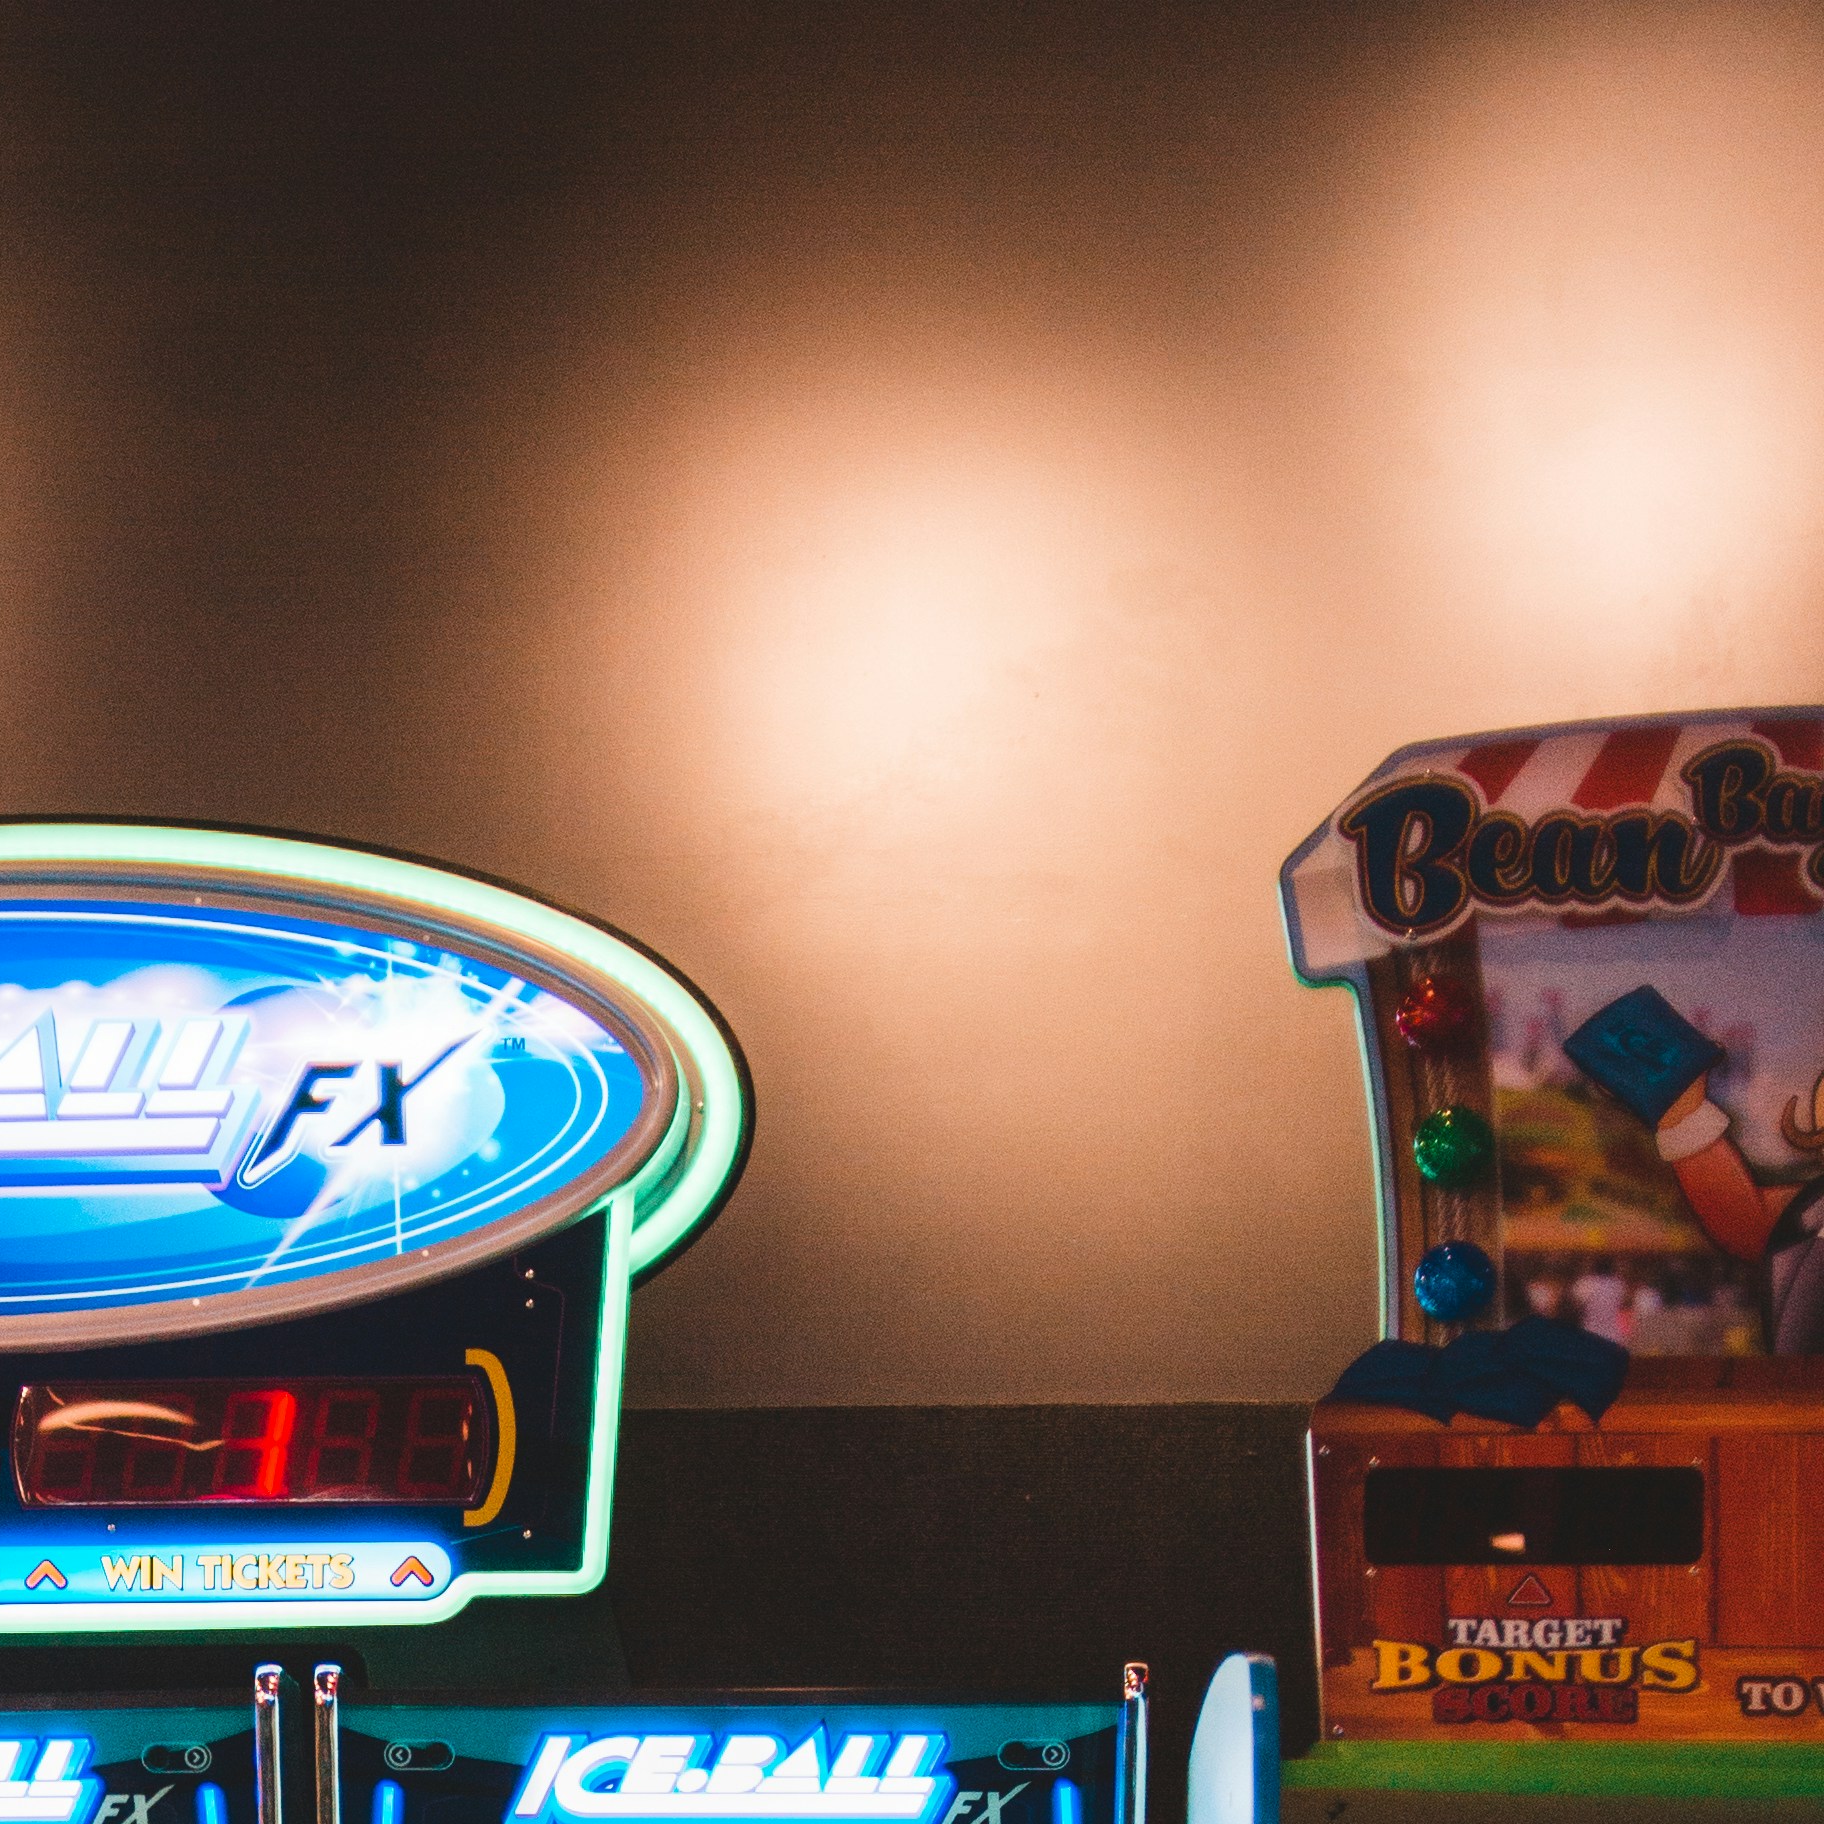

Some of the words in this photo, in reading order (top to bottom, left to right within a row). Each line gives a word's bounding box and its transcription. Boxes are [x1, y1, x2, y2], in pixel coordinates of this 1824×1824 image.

[1338, 775, 1722, 932] Bean
[1681, 740, 1824, 890] Ba
[238, 1012, 486, 1186] FX
[101, 1555, 183, 1591] WIN
[196, 1553, 354, 1590] TICKETS
[1447, 1617, 1622, 1648] TARGET
[1372, 1639, 1697, 1694] BONUS
[1434, 1689, 1637, 1722] SCORE
[1742, 1680, 1806, 1711] TO
